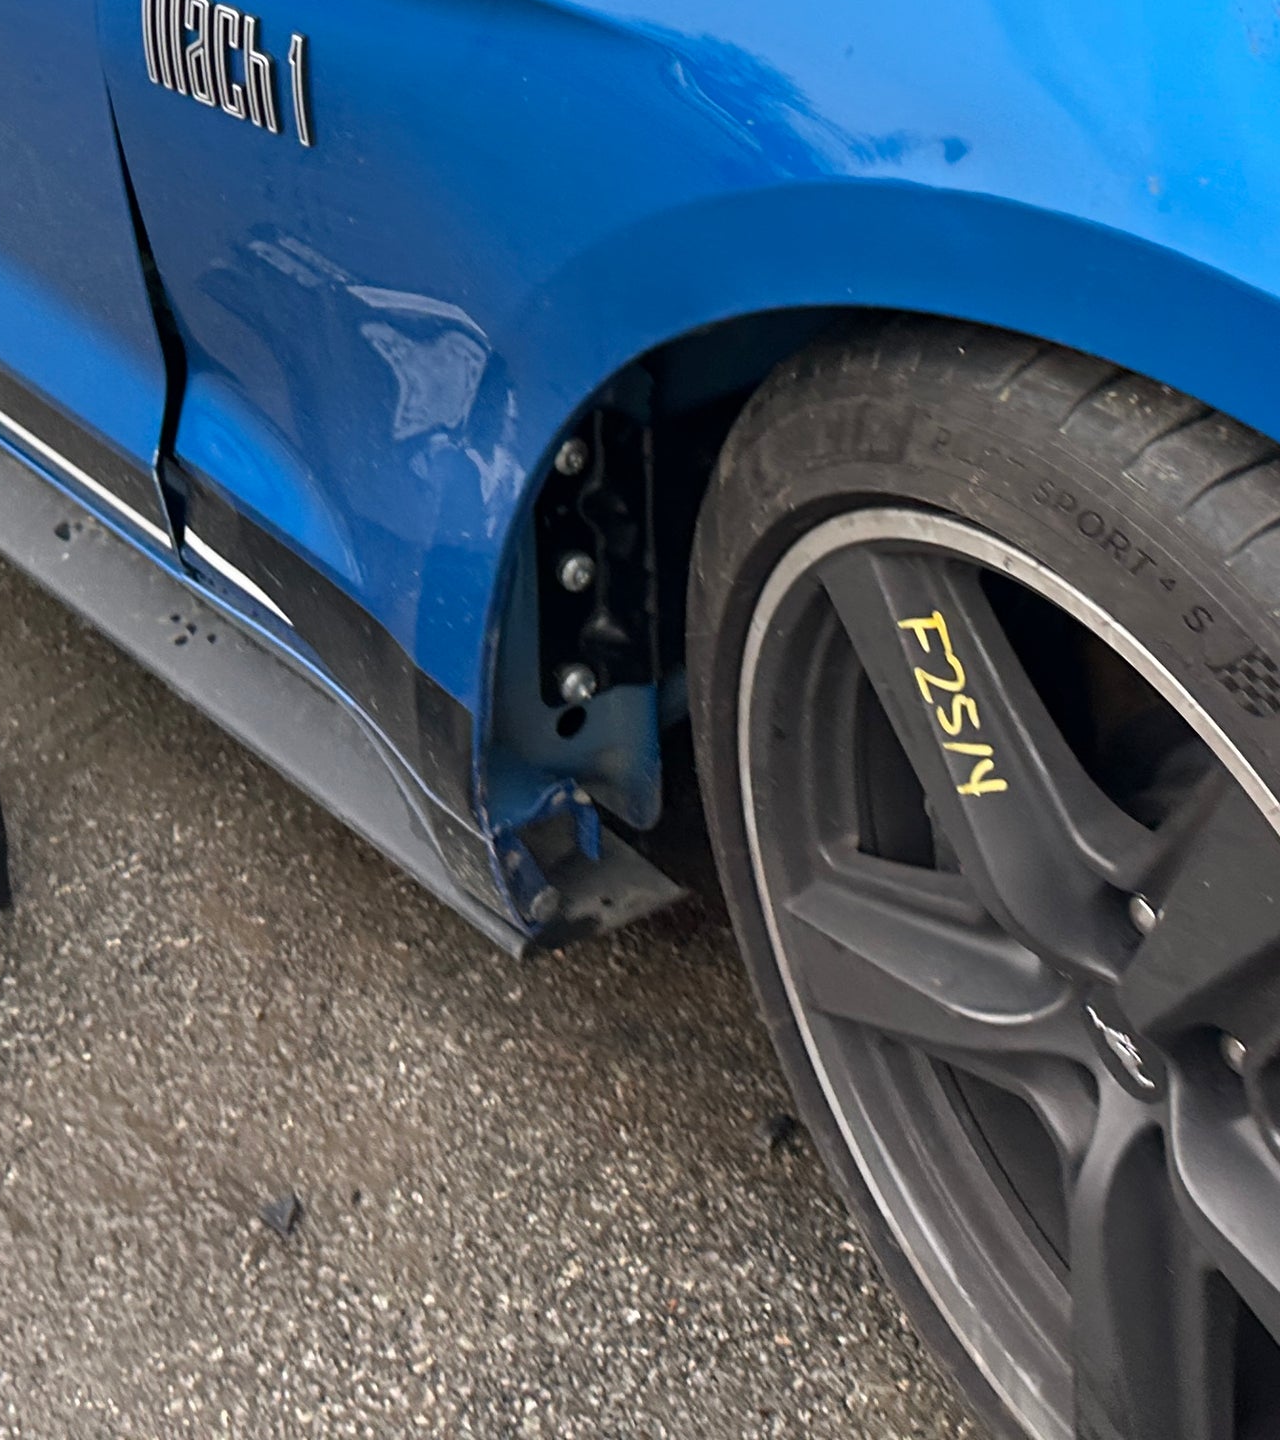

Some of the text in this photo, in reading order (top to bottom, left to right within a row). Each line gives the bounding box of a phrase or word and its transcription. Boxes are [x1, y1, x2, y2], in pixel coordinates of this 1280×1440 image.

[287, 32, 312, 147] 1
[1031, 479, 1159, 577] SPORT
[1182, 605, 1215, 634] S
[897, 610, 1009, 797] F2514
